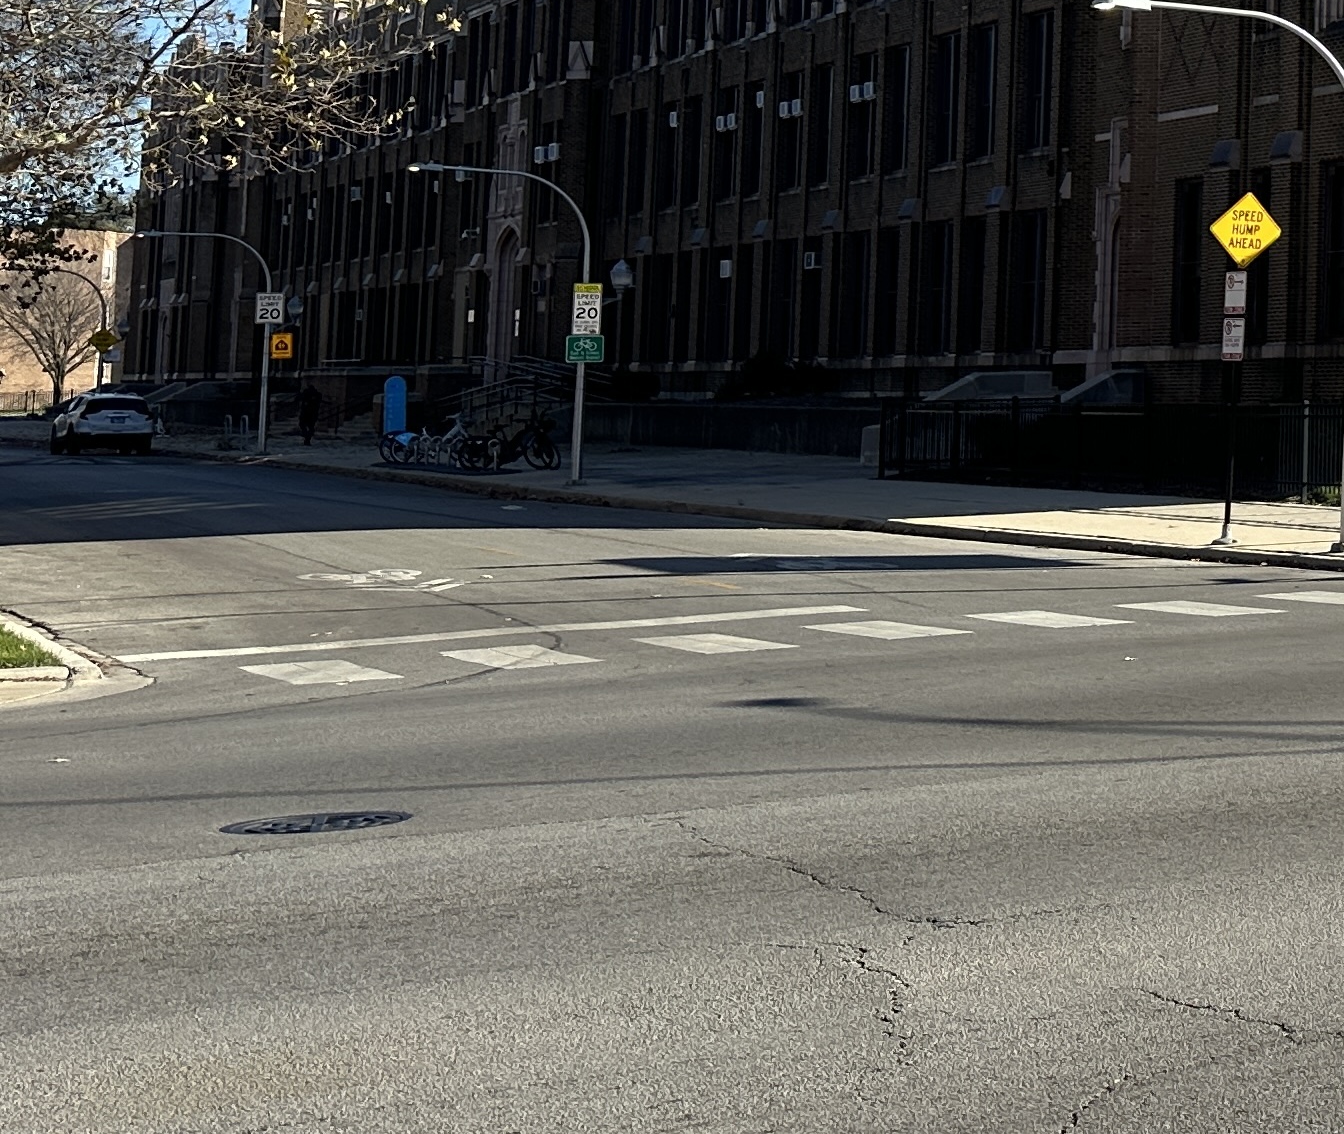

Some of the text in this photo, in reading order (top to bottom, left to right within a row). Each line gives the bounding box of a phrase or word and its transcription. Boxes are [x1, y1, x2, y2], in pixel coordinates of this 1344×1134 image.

[1232, 209, 1263, 222] SPEED
[1232, 223, 1260, 235] HUMP
[1228, 237, 1261, 250] AHEAD
[259, 308, 280, 319] 20
[576, 307, 598, 319] 20
